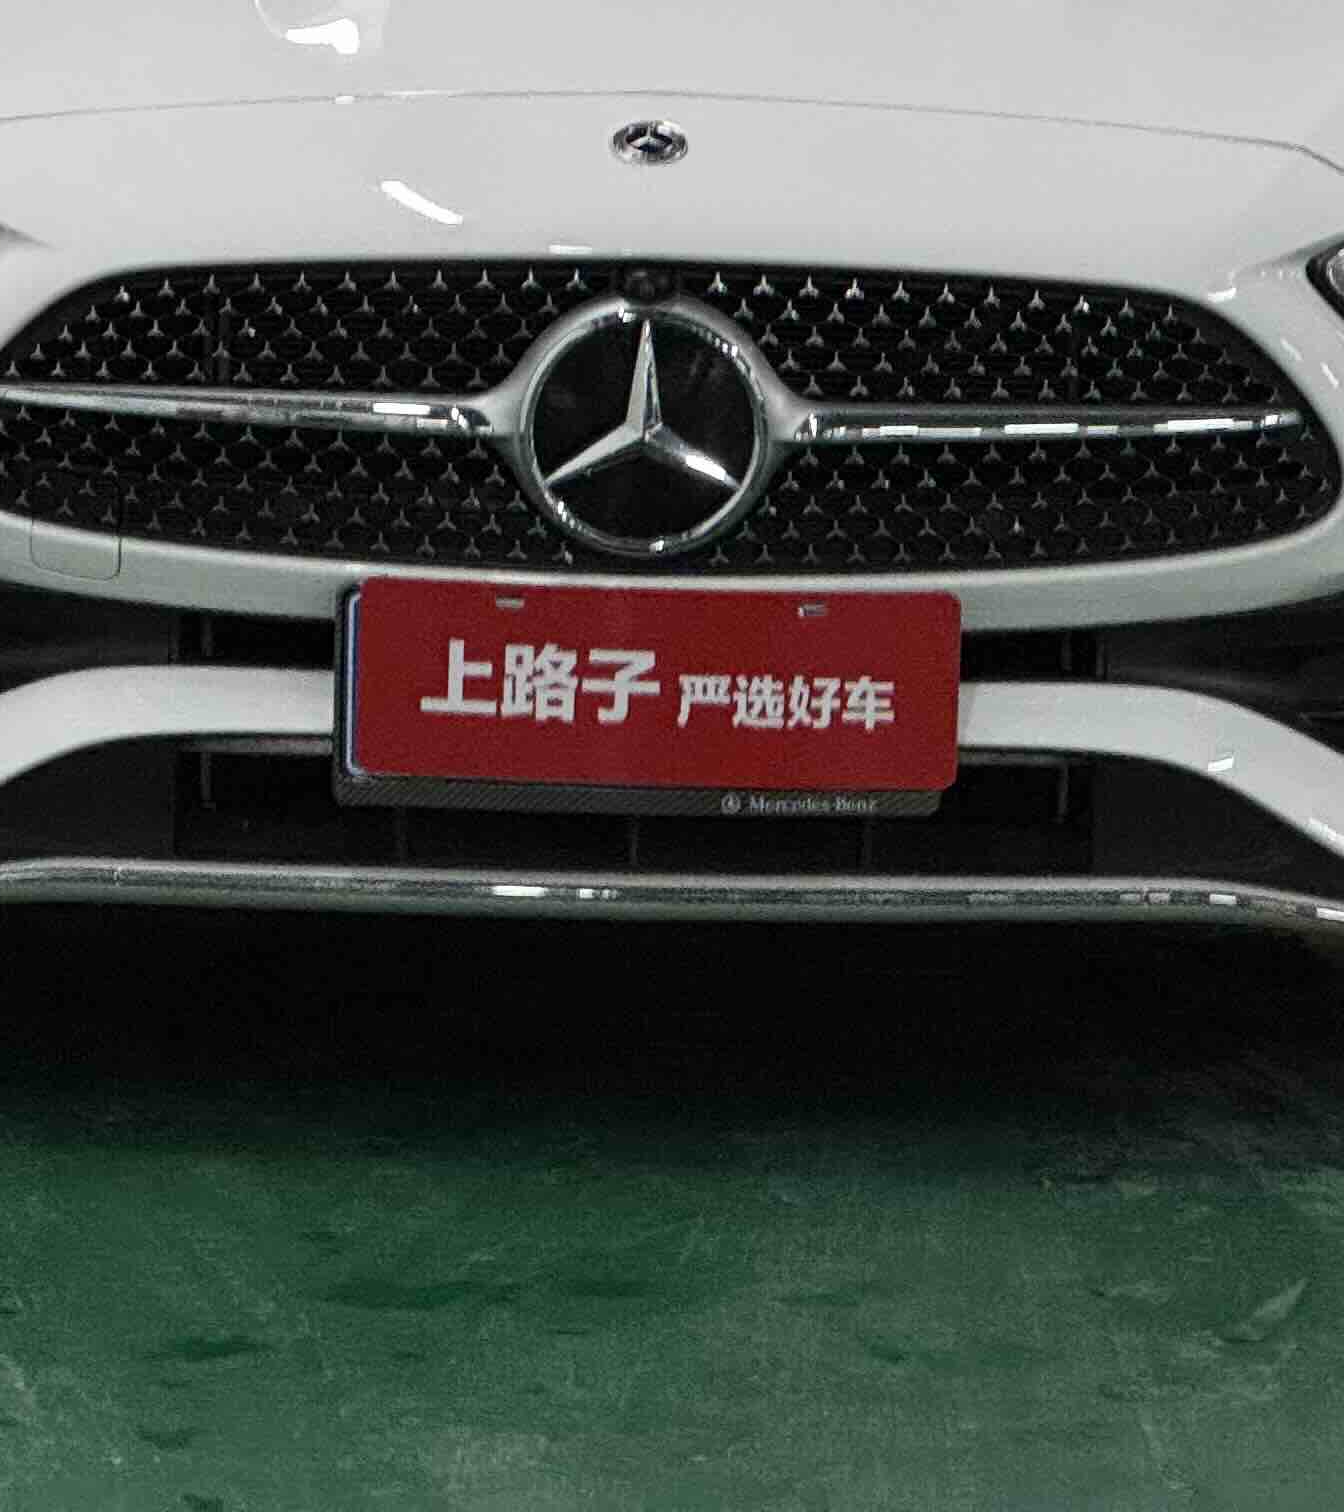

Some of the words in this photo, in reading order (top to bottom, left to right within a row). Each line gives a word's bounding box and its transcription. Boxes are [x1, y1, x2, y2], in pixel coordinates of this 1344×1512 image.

[420, 637, 661, 724] 上路子
[678, 673, 896, 732] 严选好车
